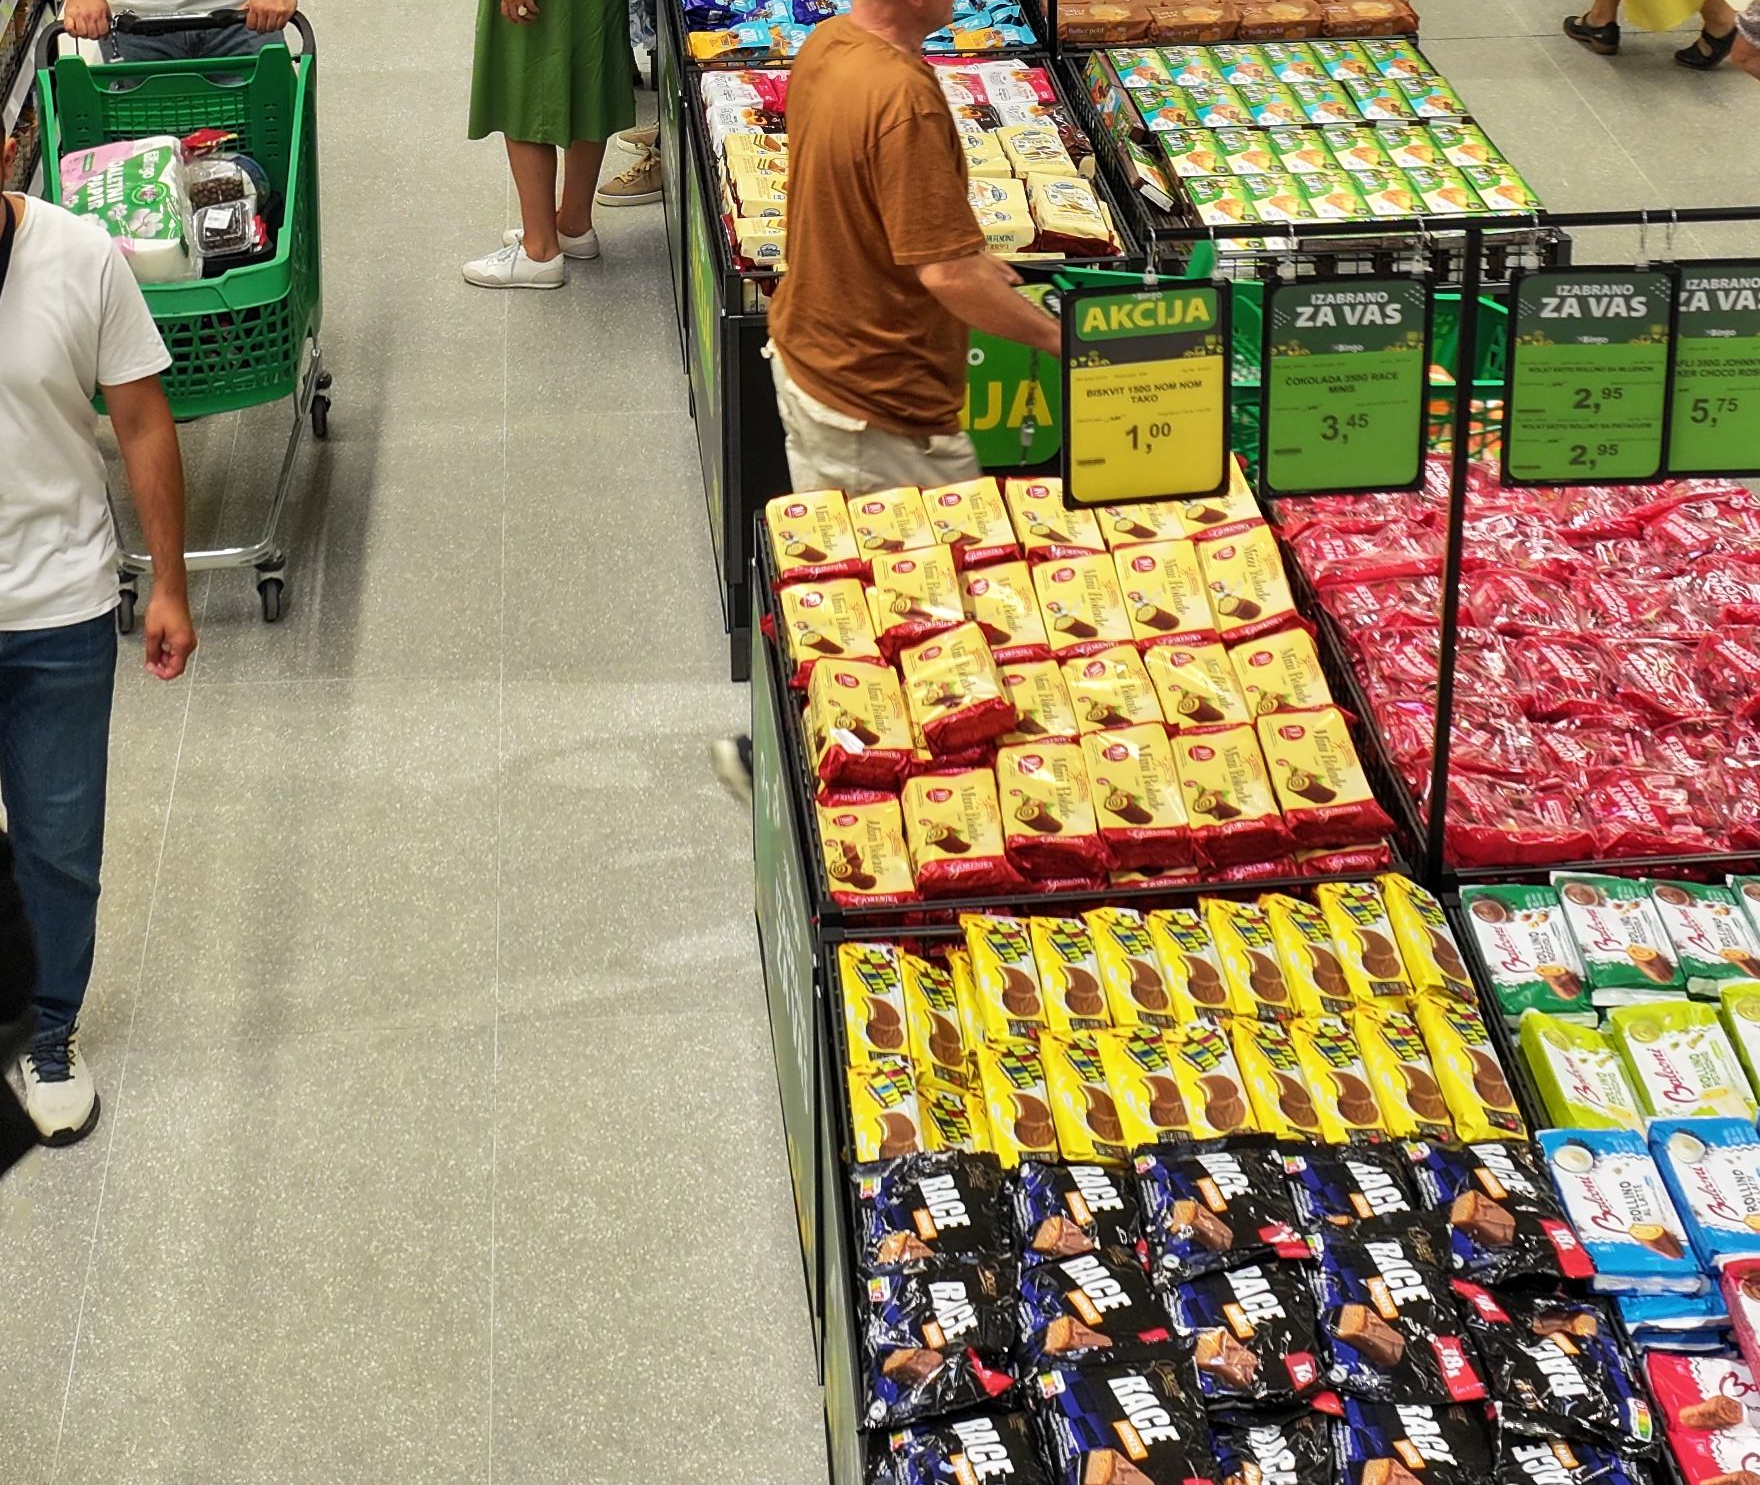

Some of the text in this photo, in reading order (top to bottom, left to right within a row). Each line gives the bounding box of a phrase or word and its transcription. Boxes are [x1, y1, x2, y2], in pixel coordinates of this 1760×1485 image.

[1310, 292, 1388, 305] IZABRANO
[1556, 284, 1634, 296] IZABRANO
[1083, 298, 1210, 333] AKCIJA
[1295, 303, 1403, 328] ZA VAS
[1540, 296, 1648, 318] ZA VAS
[1154, 383, 1177, 392] NOM
[1179, 381, 1203, 391] NOM
[1573, 387, 1623, 414] 2,95
[1690, 398, 1738, 427] 5,75
[1125, 423, 1172, 455] 1,00
[1320, 413, 1369, 445] 3,45
[1568, 444, 1619, 470] 2,95
[919, 1174, 970, 1230] RACE
[1059, 1255, 1132, 1313] RACE
[1107, 1376, 1180, 1446] RACE
